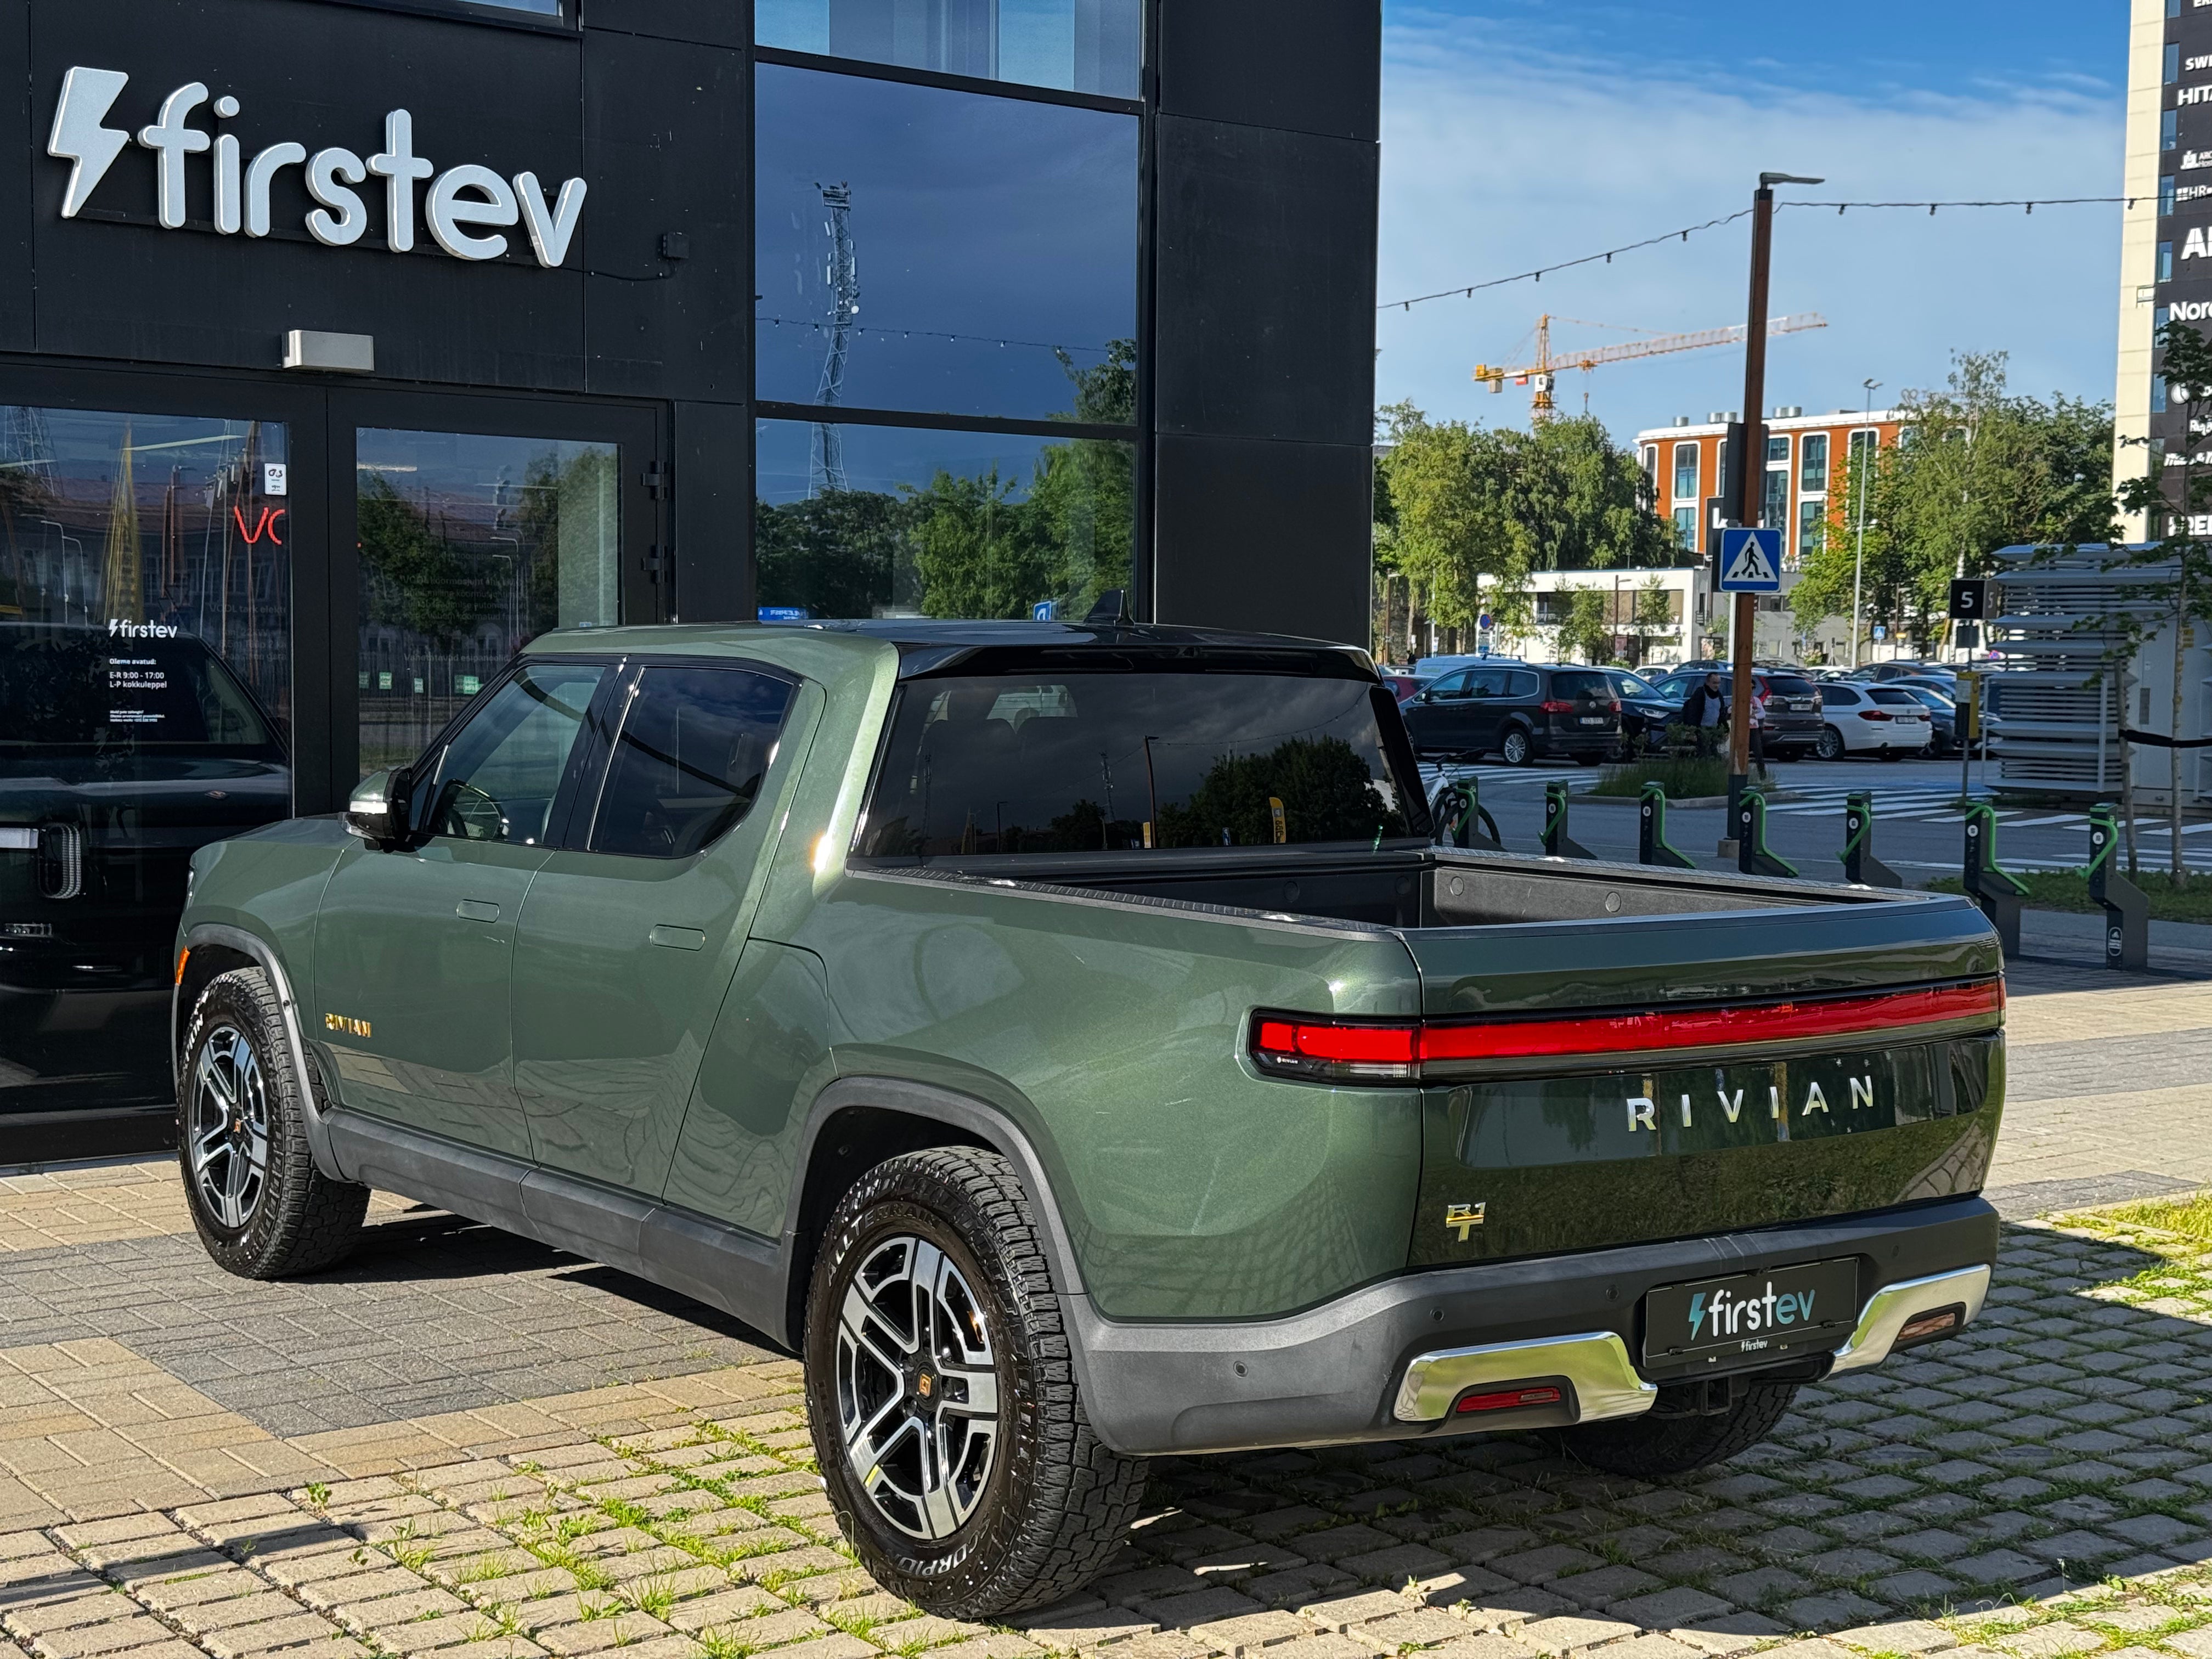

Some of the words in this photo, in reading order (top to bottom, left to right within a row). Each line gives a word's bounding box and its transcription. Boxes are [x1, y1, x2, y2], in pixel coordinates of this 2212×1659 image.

[2177, 84, 2212, 106] HIT
[138, 82, 588, 268] firstev
[1961, 591, 1974, 608] 5
[119, 619, 178, 639] firstev
[123, 680, 167, 690] kokkuleppel
[1626, 1075, 1874, 1132] RIVIAN
[1708, 1281, 1815, 1337] firstev
[1745, 1339, 1768, 1351] firstev
